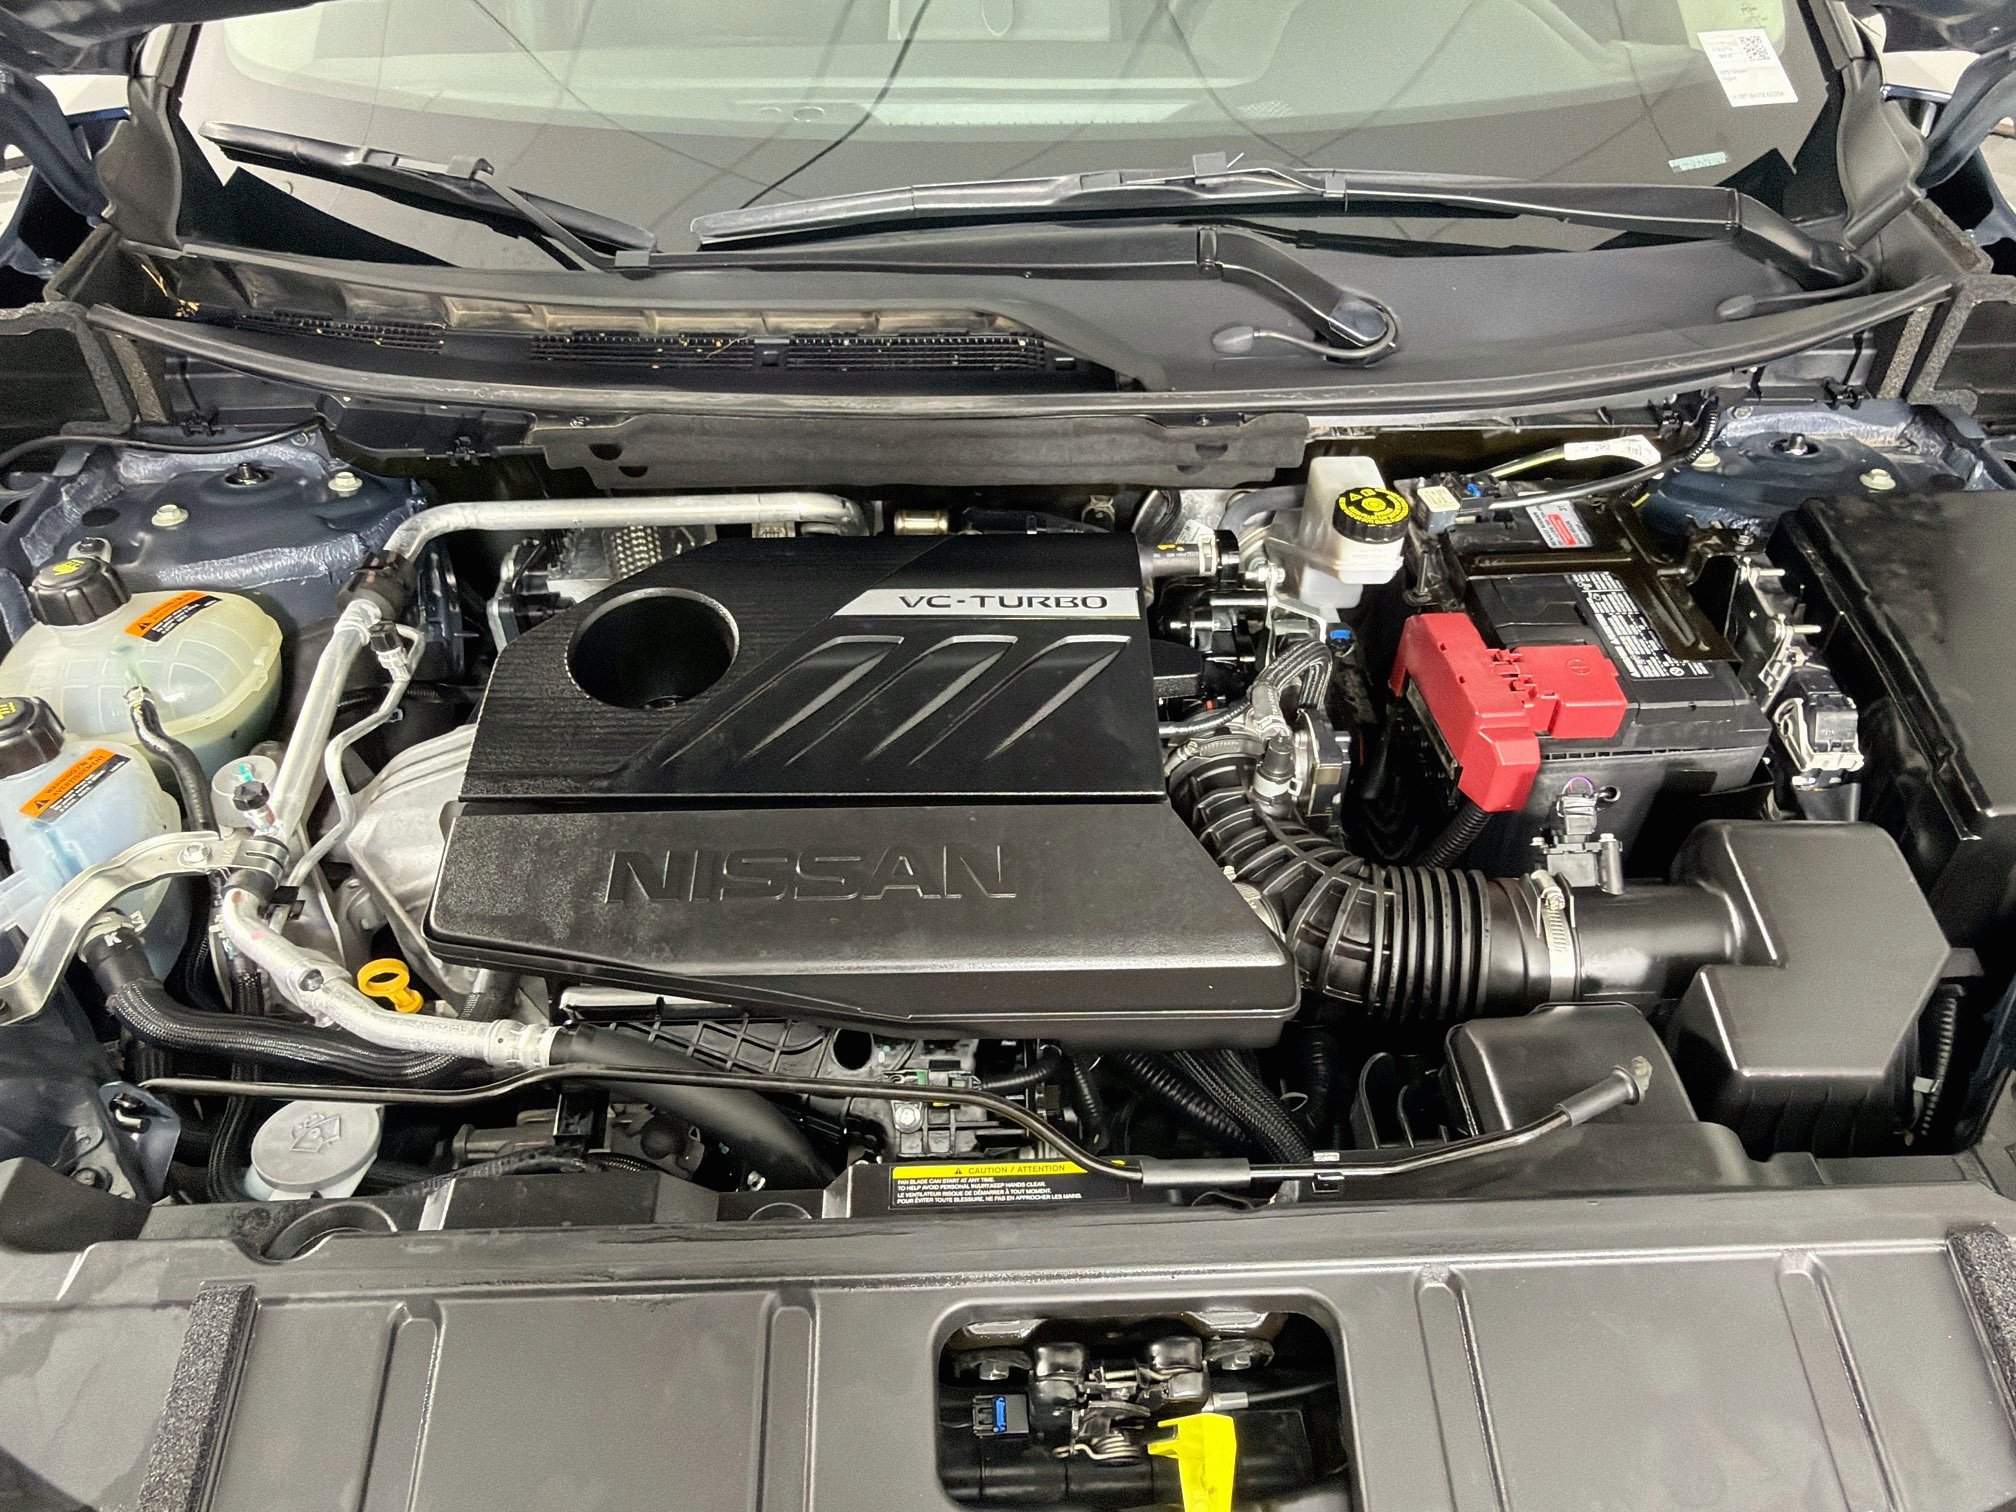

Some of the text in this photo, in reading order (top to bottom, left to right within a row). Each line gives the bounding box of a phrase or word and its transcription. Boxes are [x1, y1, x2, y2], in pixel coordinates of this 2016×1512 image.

[899, 594, 1109, 609] VC-TURBO
[52, 755, 106, 796] AVERTISSEMENT
[603, 846, 1017, 904] NISSAN
[968, 1166, 1008, 1175] CAUTION
[1017, 1164, 1065, 1173] ATTENTION
